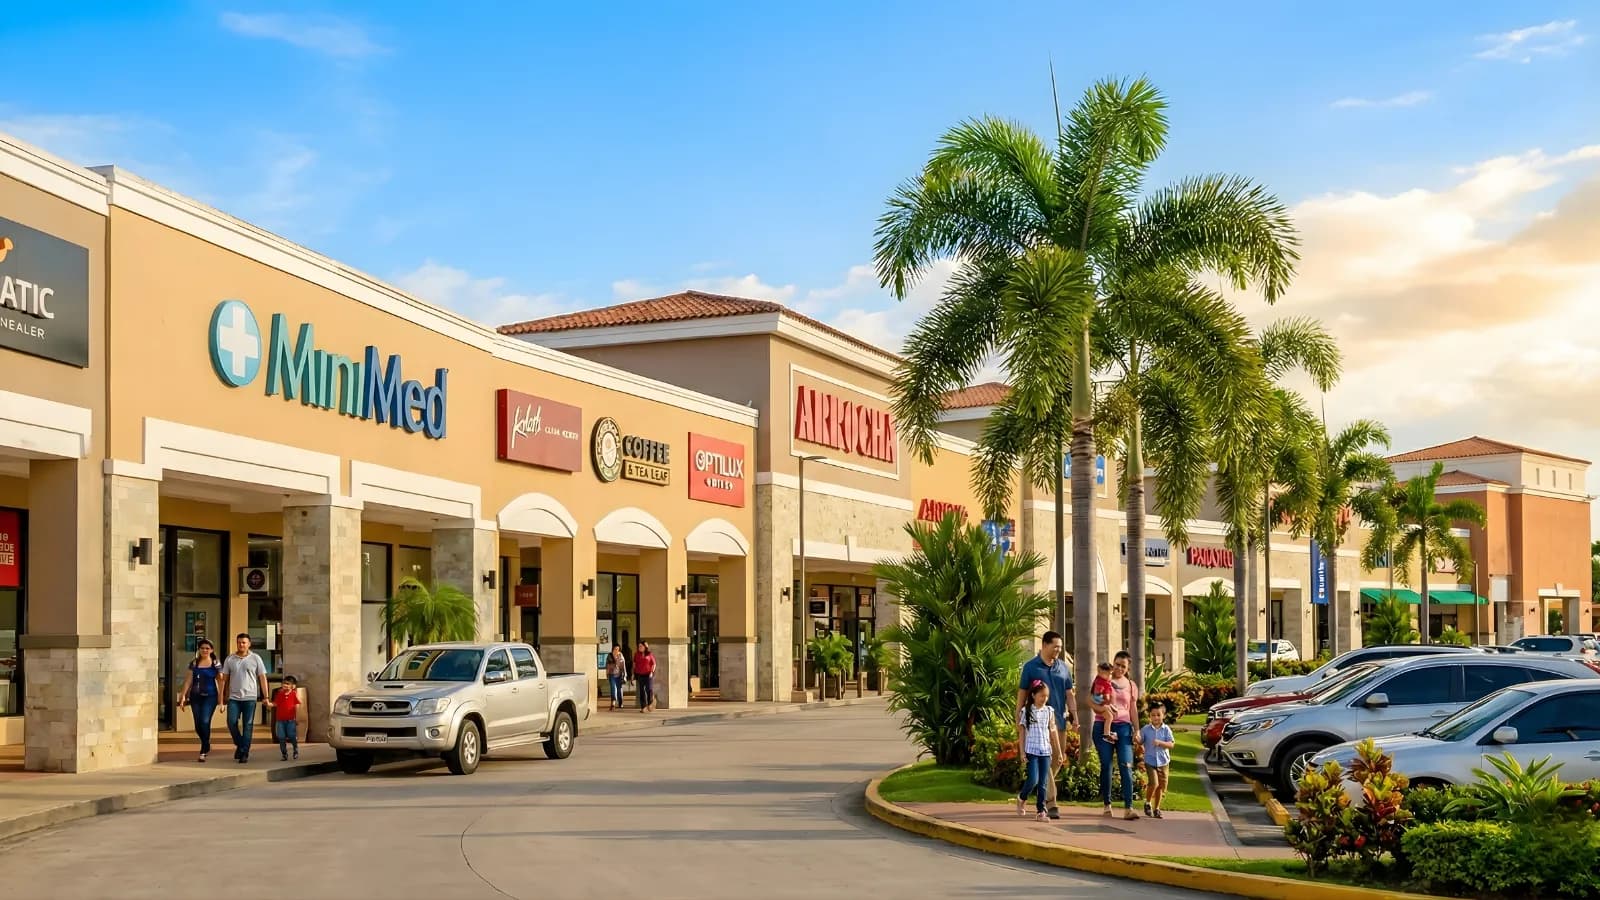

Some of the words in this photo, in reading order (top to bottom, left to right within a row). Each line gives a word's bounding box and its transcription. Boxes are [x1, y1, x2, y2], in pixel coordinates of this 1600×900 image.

[0, 275, 55, 320] ATIC
[0, 316, 46, 340] NEALER
[264, 312, 446, 440] MiniMed
[622, 435, 670, 465] COFFEE
[695, 449, 744, 479] OPTILUX
[635, 465, 648, 478] TEA
